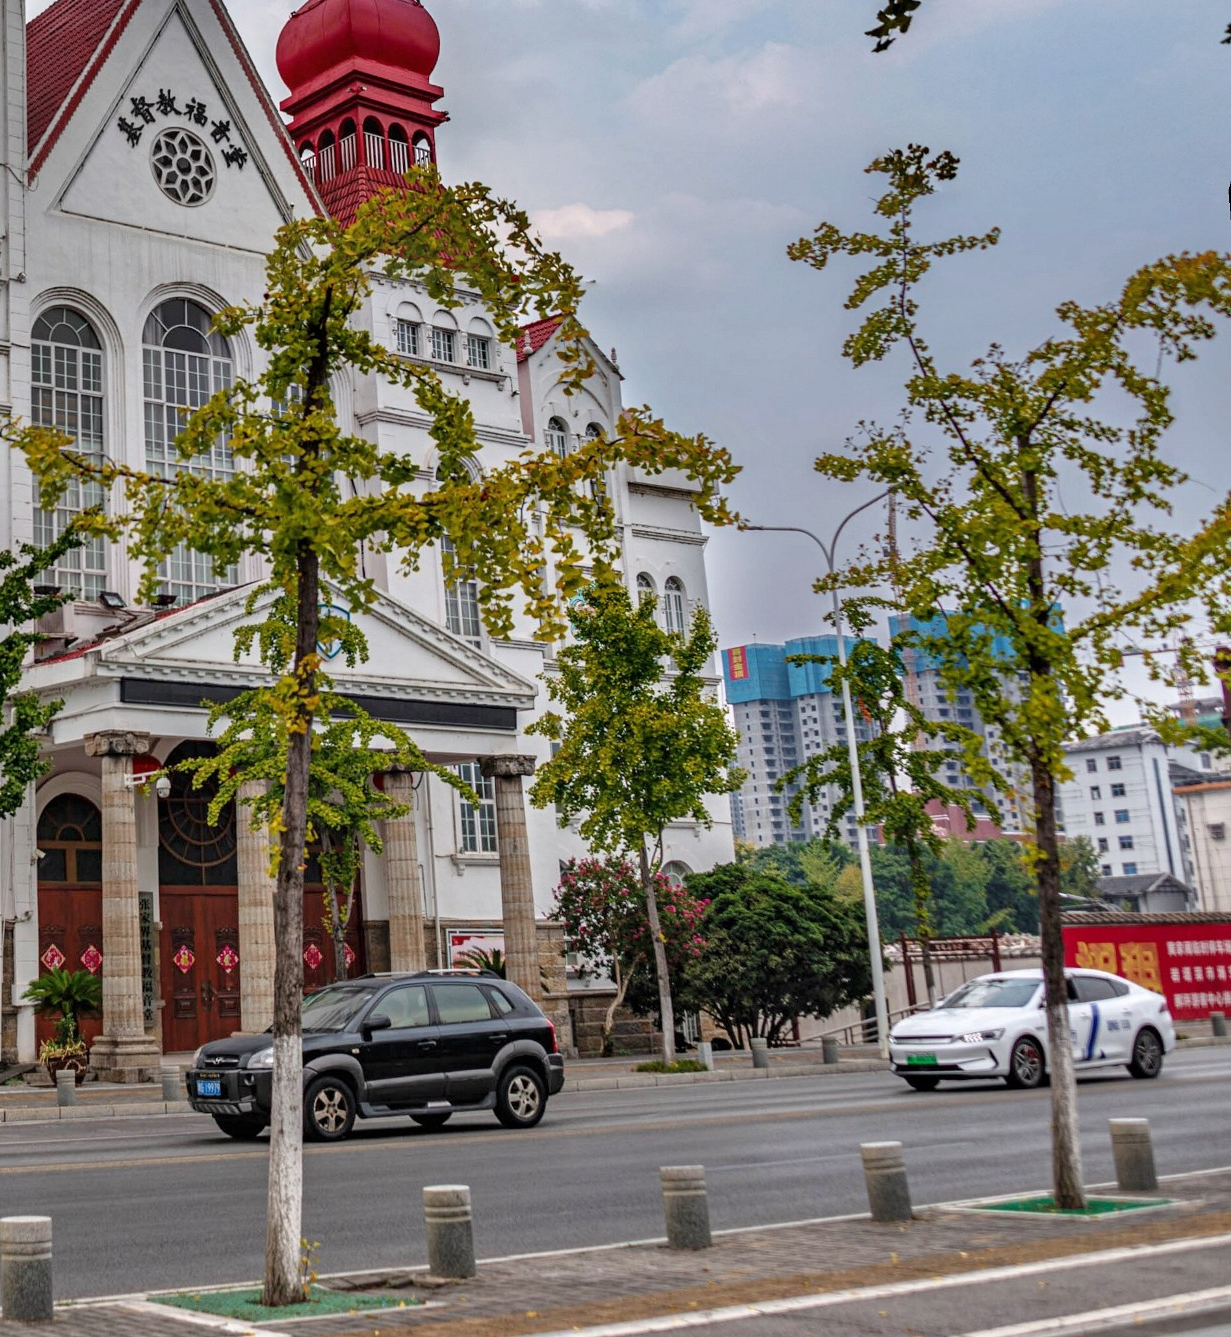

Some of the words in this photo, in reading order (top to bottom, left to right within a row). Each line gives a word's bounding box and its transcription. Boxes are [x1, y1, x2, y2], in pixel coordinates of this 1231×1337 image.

[117, 88, 248, 170] 基督教福音堂
[139, 898, 153, 1021] 张家界基督教福音堂
